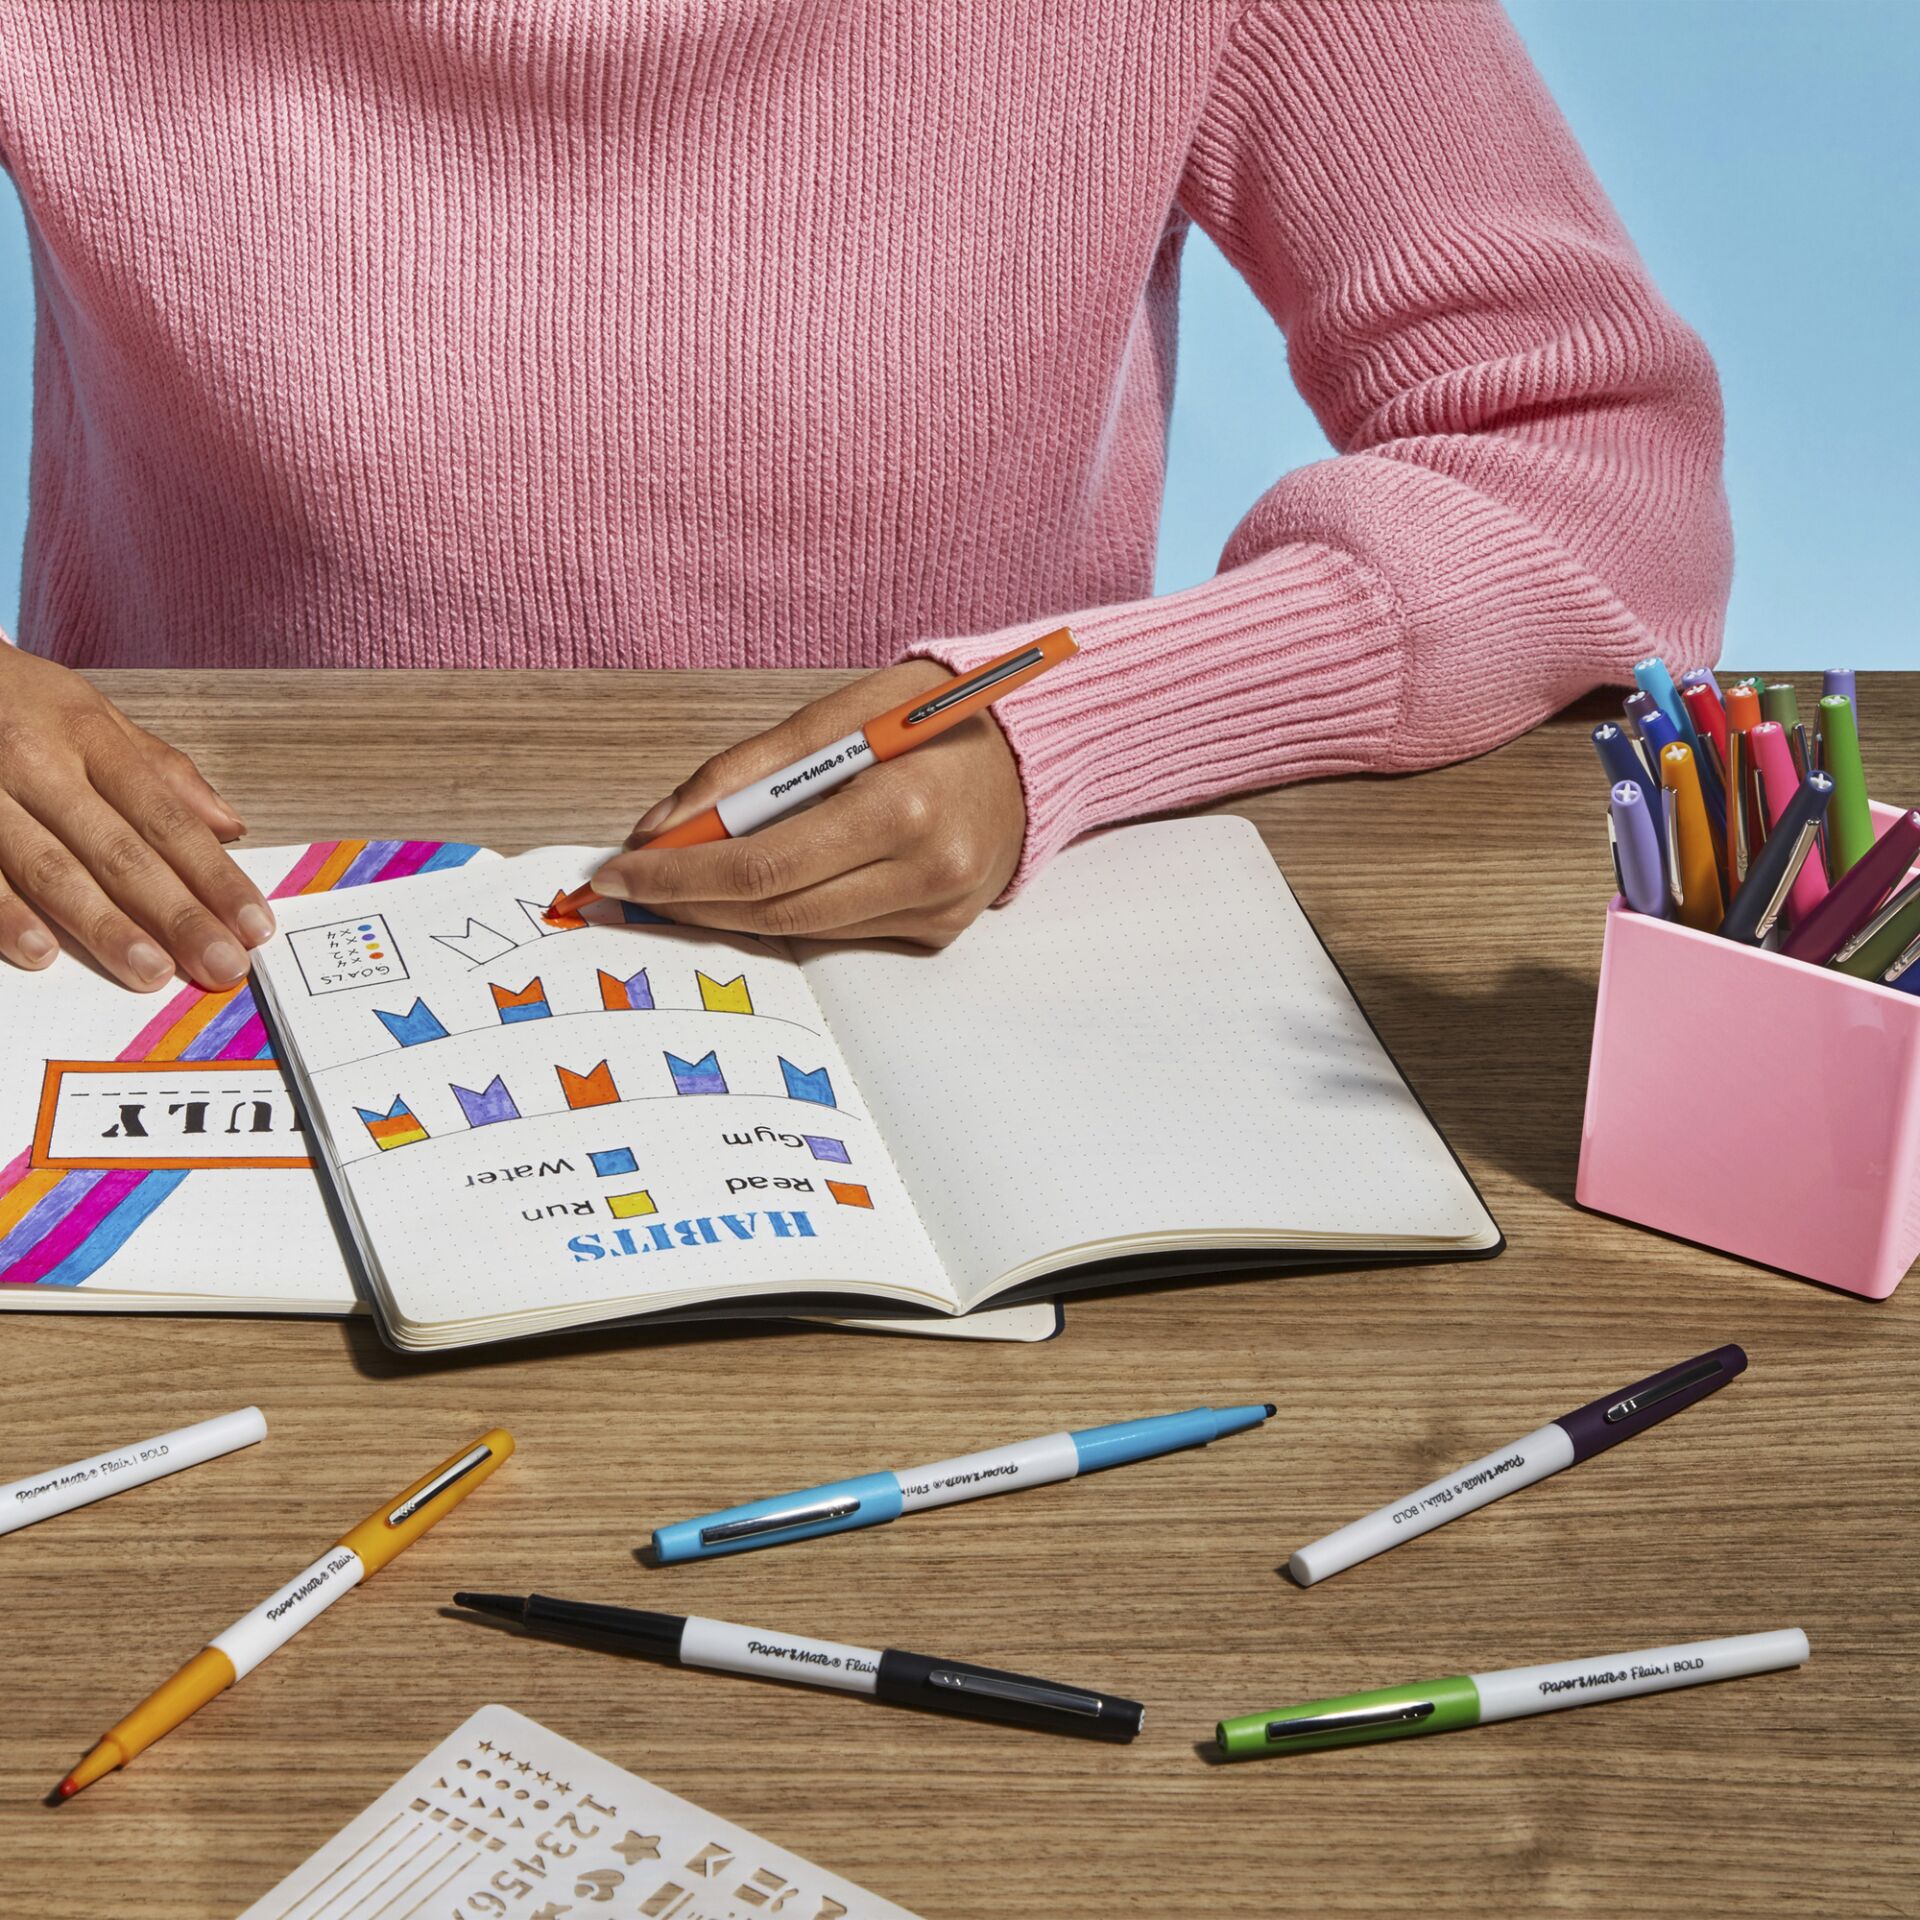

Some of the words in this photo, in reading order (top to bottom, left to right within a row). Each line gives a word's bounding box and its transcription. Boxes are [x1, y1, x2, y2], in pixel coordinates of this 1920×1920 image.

[320, 965, 390, 985] GOALS
[721, 1126, 804, 1149] Gym
[464, 1157, 576, 1188] Water
[725, 1175, 816, 1195] Read
[521, 1200, 596, 1222] Run
[567, 1209, 818, 1263] HABITS
[100, 1457, 132, 1476] Flair
[139, 1444, 170, 1463] BOLD
[1392, 1505, 1419, 1525] BOLD
[327, 1554, 355, 1575] Flair
[1630, 1664, 1665, 1681] Flair
[1673, 1658, 1704, 1673] BOLD
